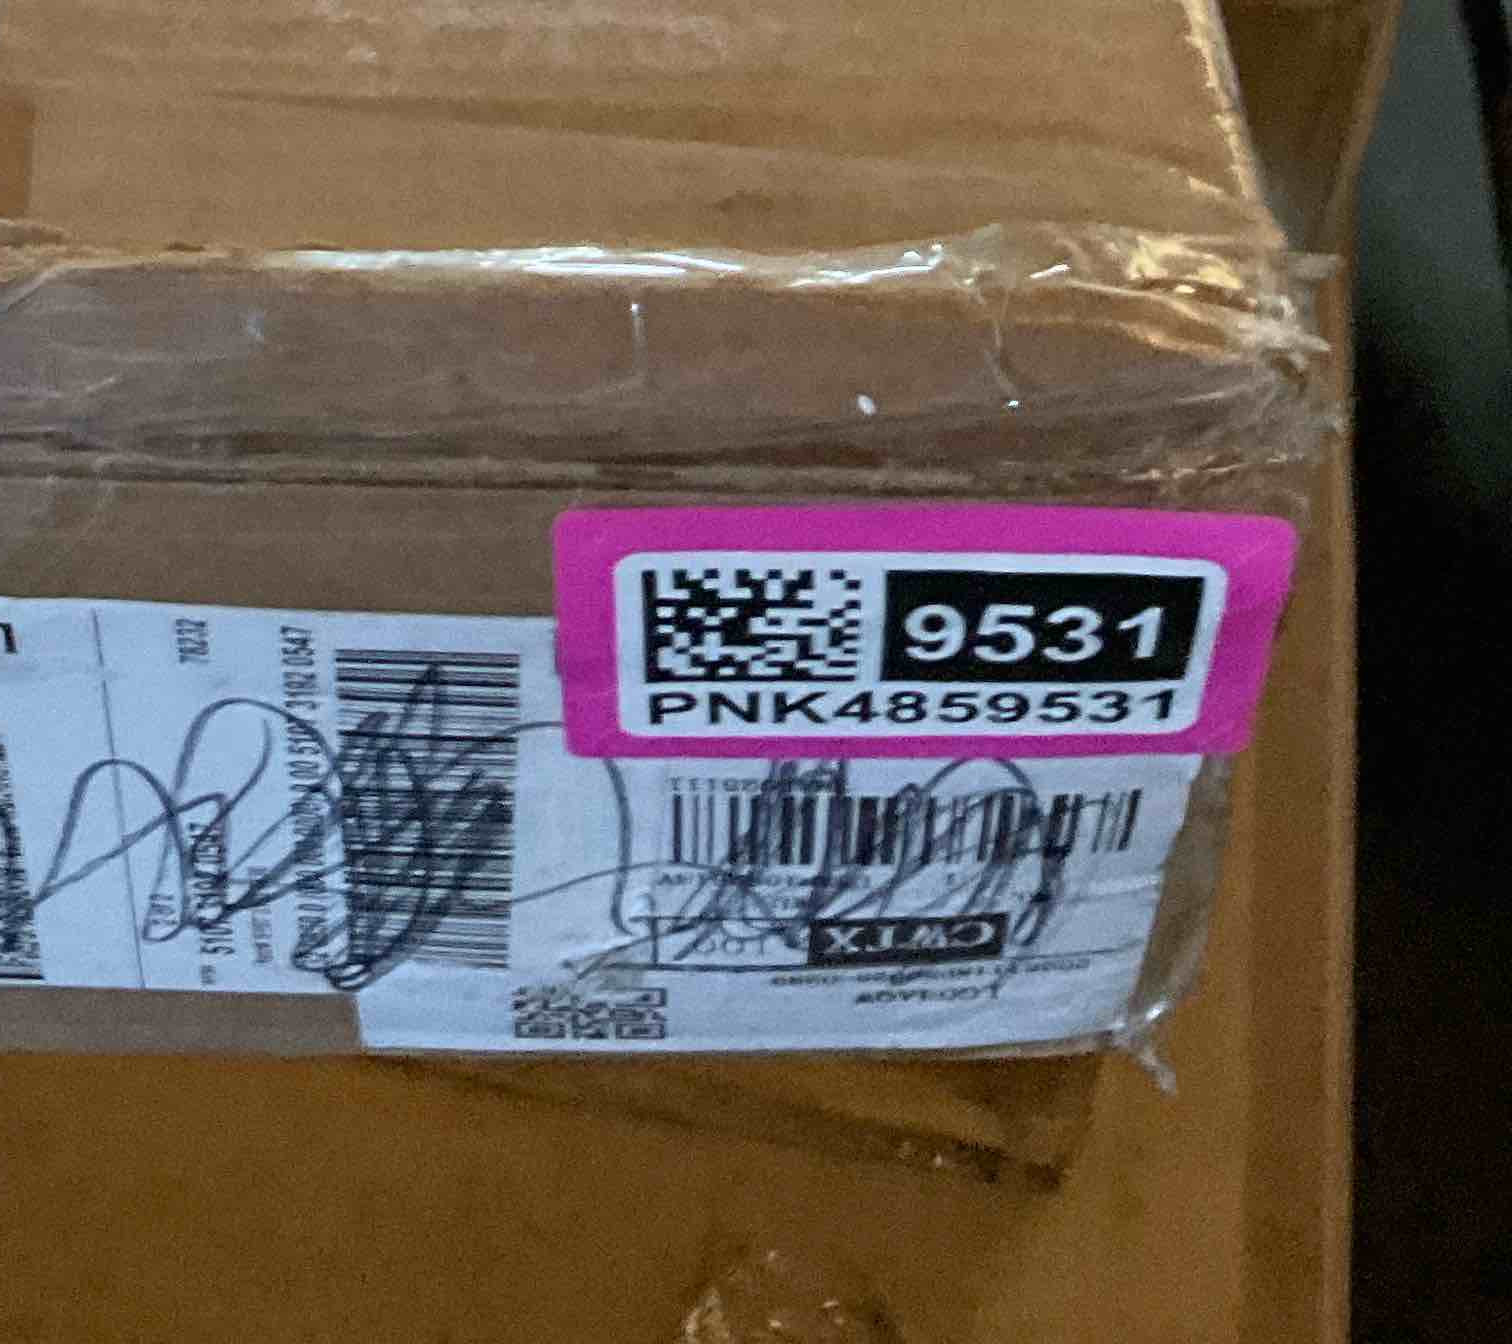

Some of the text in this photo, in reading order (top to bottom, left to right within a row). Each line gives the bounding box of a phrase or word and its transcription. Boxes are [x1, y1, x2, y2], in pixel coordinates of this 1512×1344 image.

[175, 618, 210, 664] 78232
[280, 625, 315, 666] 0547
[903, 603, 1166, 662] 9531
[648, 689, 1178, 725] PNK4859531
